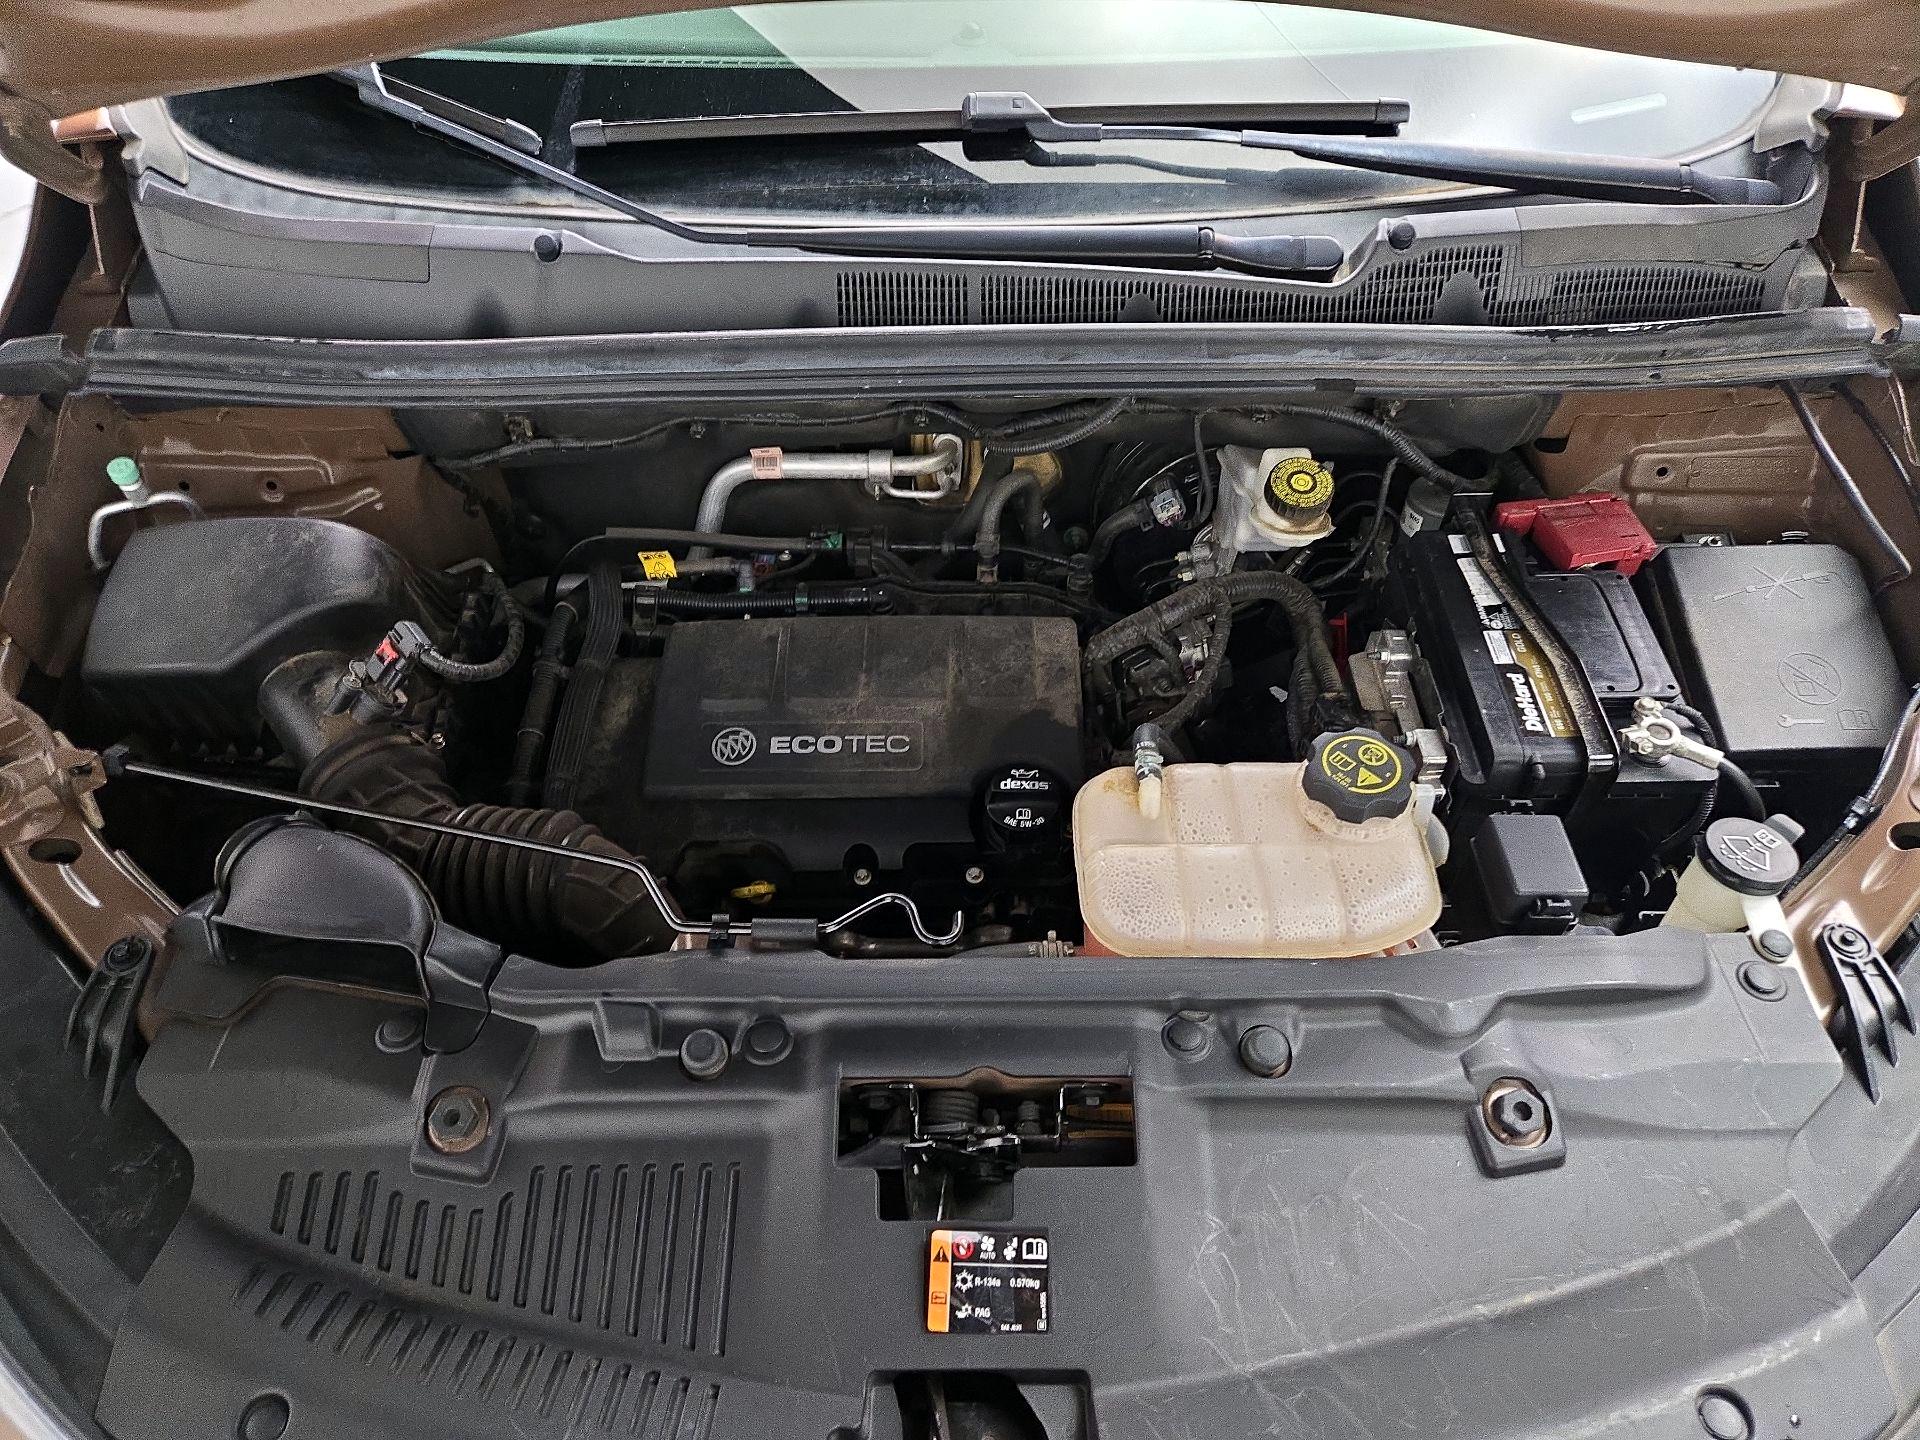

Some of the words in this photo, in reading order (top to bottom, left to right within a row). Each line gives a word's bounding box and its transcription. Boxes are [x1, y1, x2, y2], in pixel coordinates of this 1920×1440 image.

[1511, 633, 1527, 652] GOLD
[1505, 672, 1544, 731] DieHard
[769, 735, 910, 754] ECOTEC
[999, 777, 1049, 790] dexos
[1003, 815, 1018, 827] SAE
[980, 1252, 996, 1260] AUTO
[974, 1278, 1001, 1288] R-134a
[974, 1307, 991, 1318] PAG
